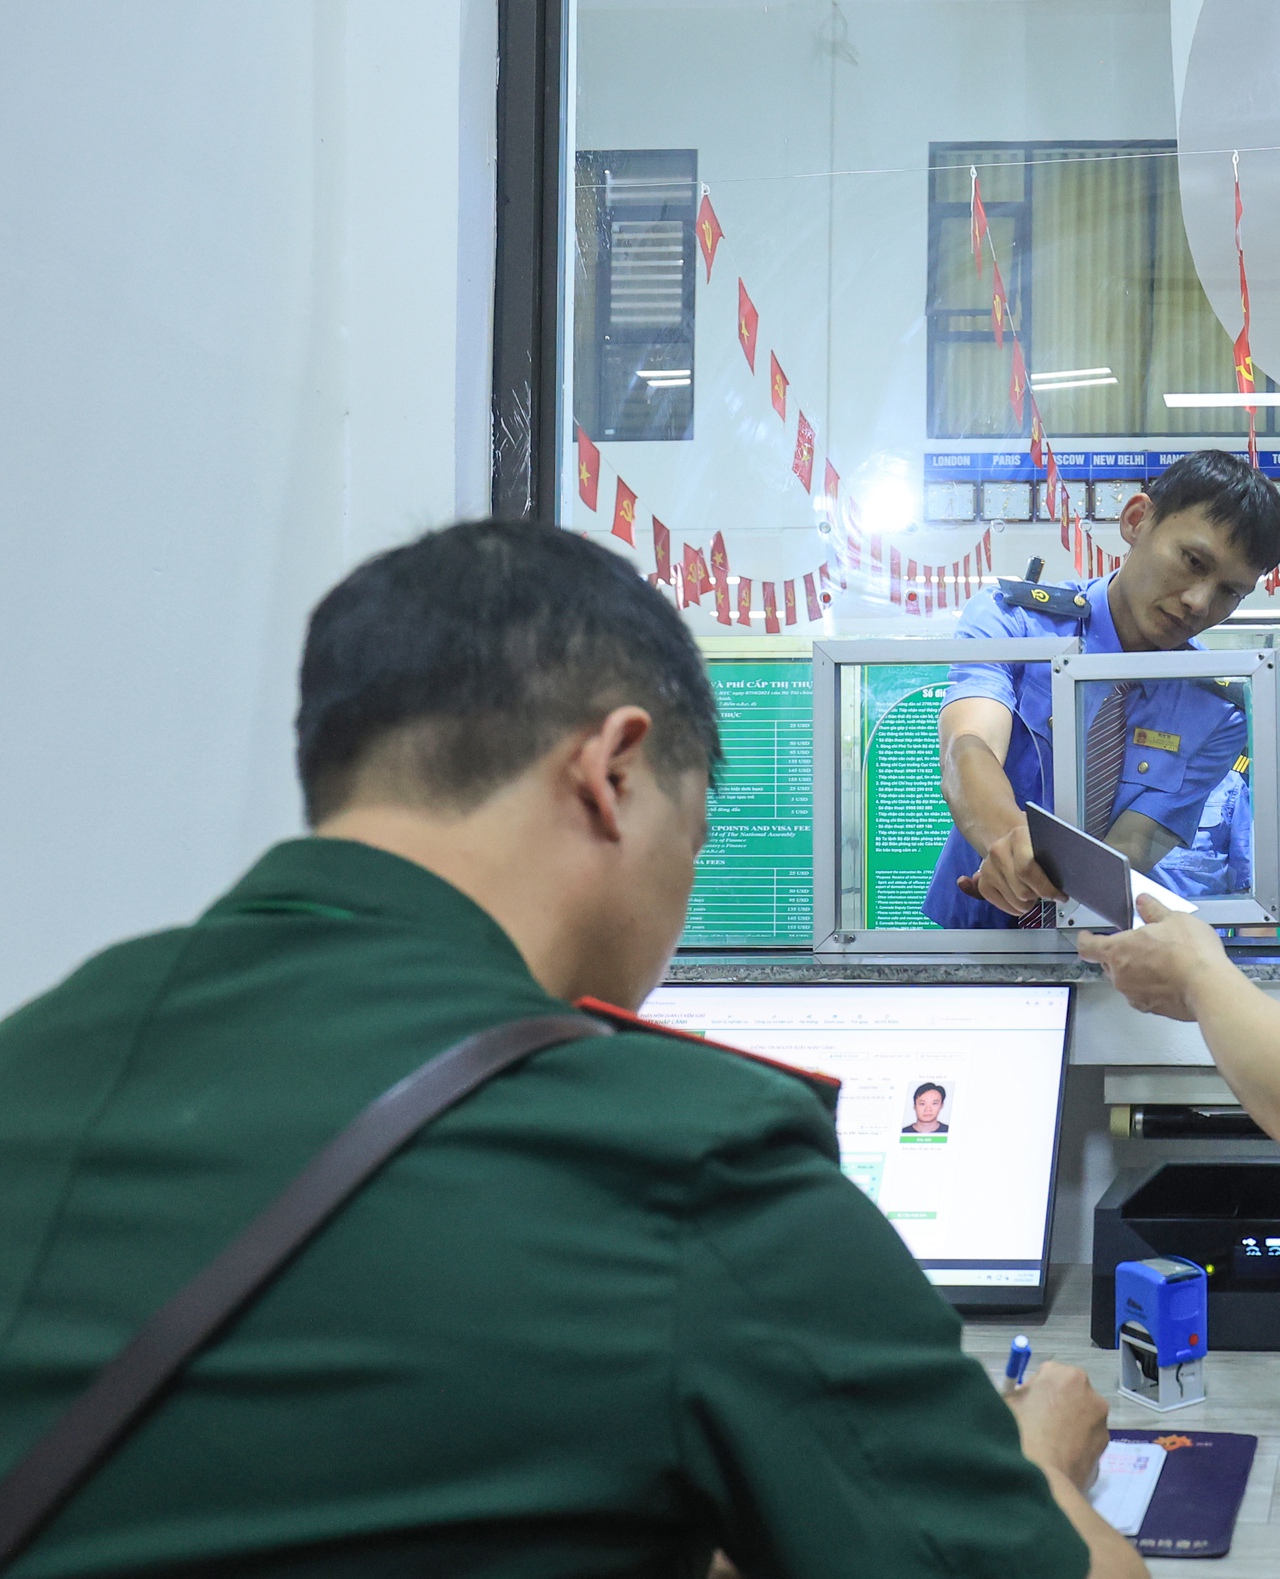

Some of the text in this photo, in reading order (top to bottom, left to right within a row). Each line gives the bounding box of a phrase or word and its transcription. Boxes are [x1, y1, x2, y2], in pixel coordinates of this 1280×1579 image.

[933, 456, 970, 466] LONDON
[993, 455, 1021, 466] PARIS
[1093, 455, 1144, 465] NEW DELHI
[726, 680, 744, 688] PHÍ
[746, 679, 768, 688] CẤP
[770, 681, 789, 689] THỊ
[922, 687, 933, 698] Số
